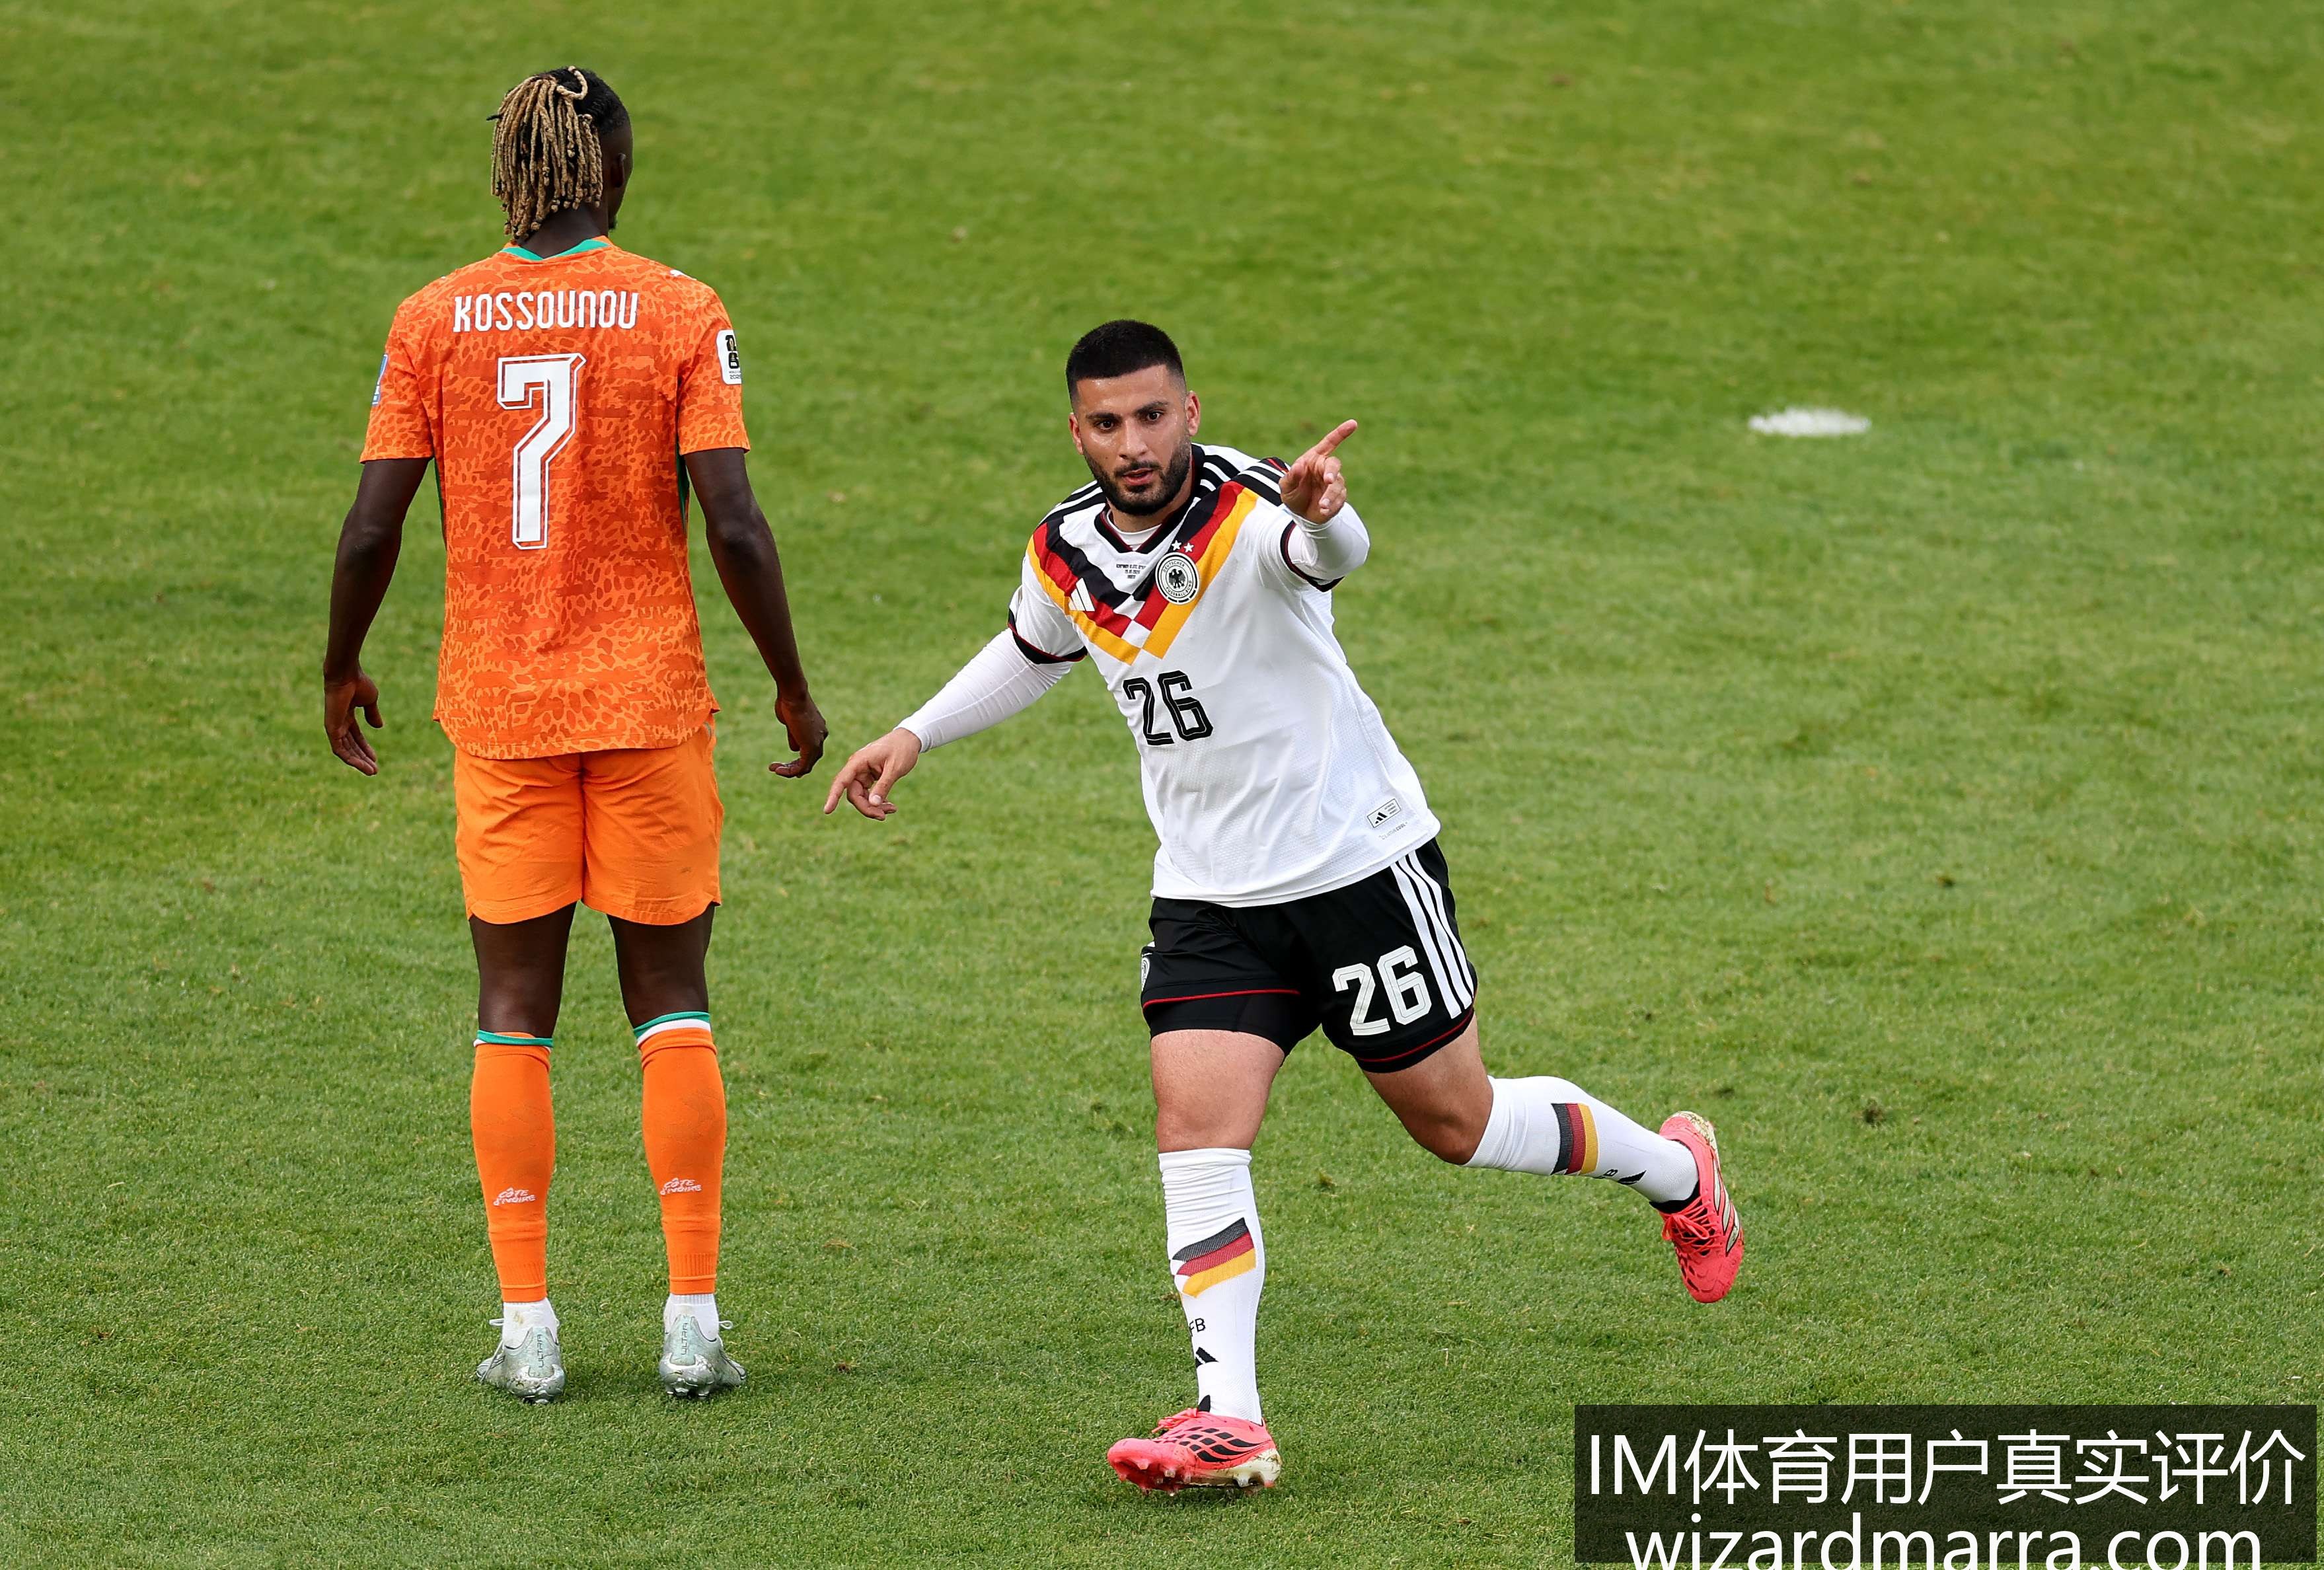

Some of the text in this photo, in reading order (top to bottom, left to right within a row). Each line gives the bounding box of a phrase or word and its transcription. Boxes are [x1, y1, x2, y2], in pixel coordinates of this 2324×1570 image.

[453, 291, 639, 332] KOSSOUNOU
[497, 352, 587, 550] 7
[1163, 560, 1185, 572] DEUTSCHER
[1123, 670, 1213, 746] 26
[1332, 945, 1432, 1036] 26
[1189, 1318, 1206, 1337] FB
